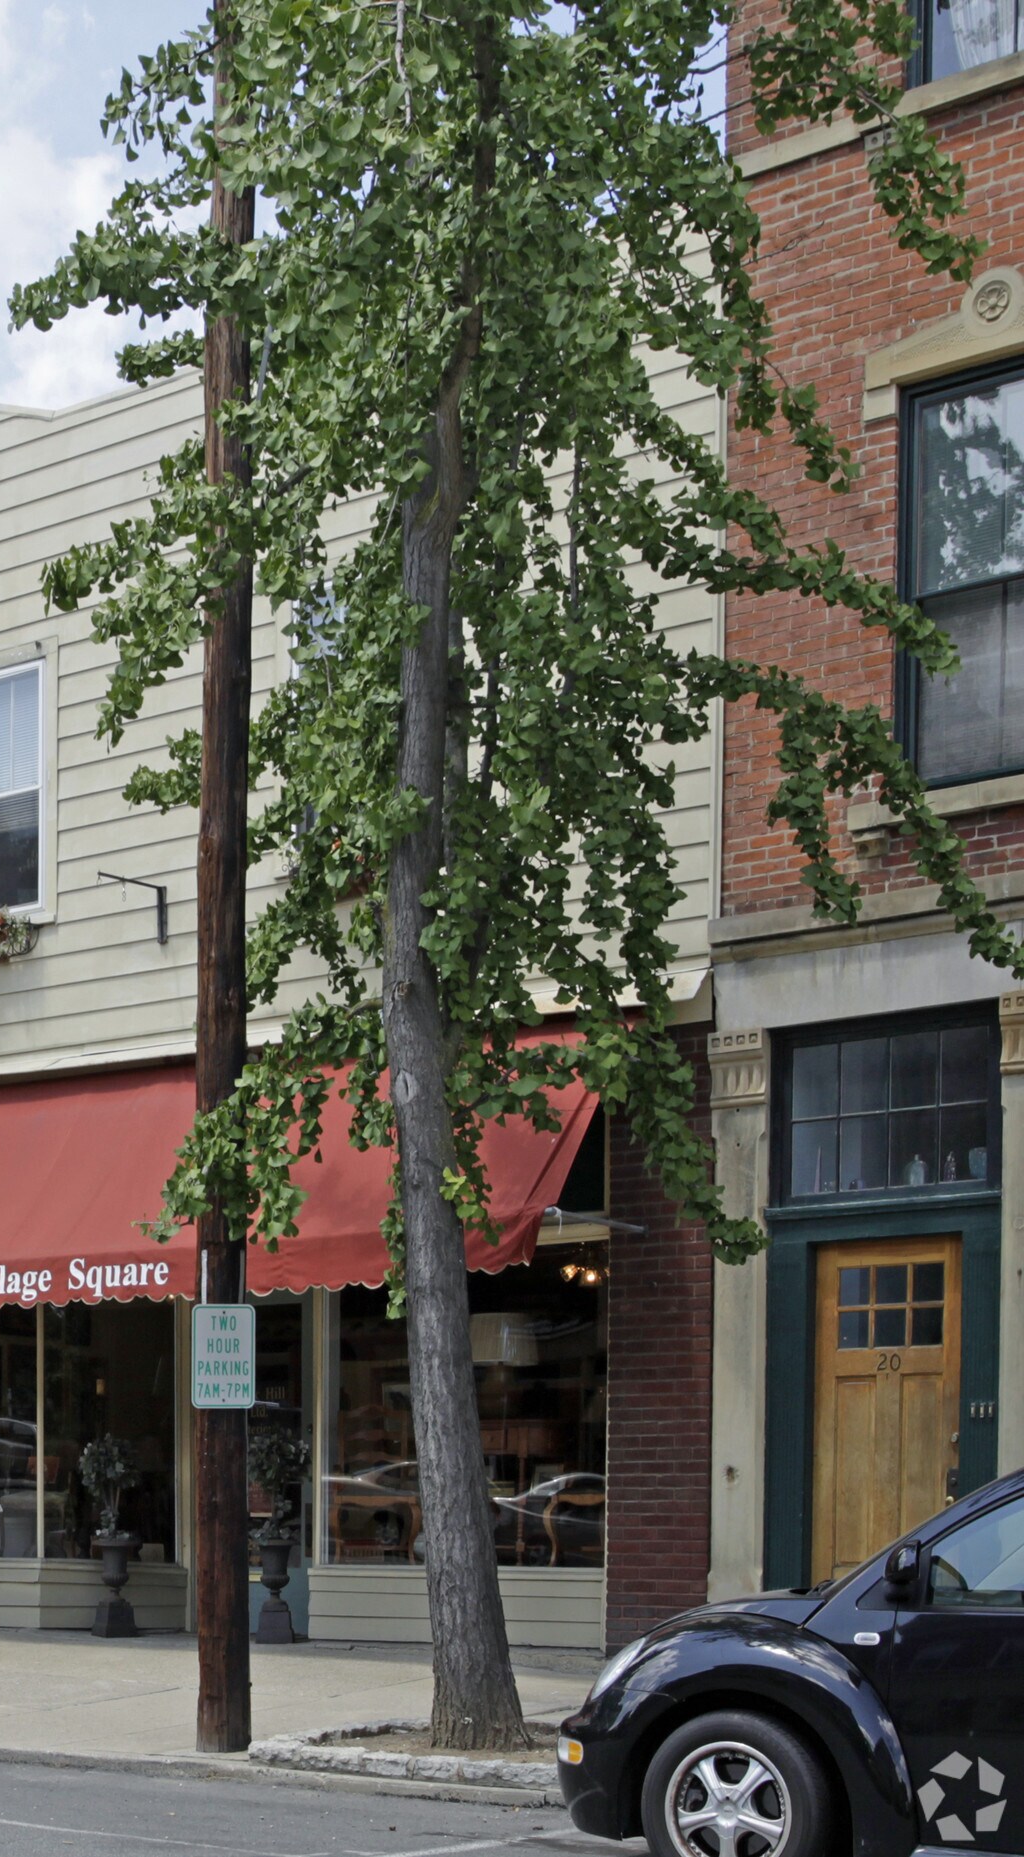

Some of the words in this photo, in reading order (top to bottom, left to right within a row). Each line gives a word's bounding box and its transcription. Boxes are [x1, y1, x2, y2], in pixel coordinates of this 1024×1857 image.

[68, 1257, 169, 1297] Square
[211, 1315, 237, 1331] TWO
[207, 1338, 240, 1354] HOUR
[197, 1360, 249, 1376] PARKING
[877, 1353, 901, 1372] 20
[197, 1382, 250, 1398] 7AM-7PM
